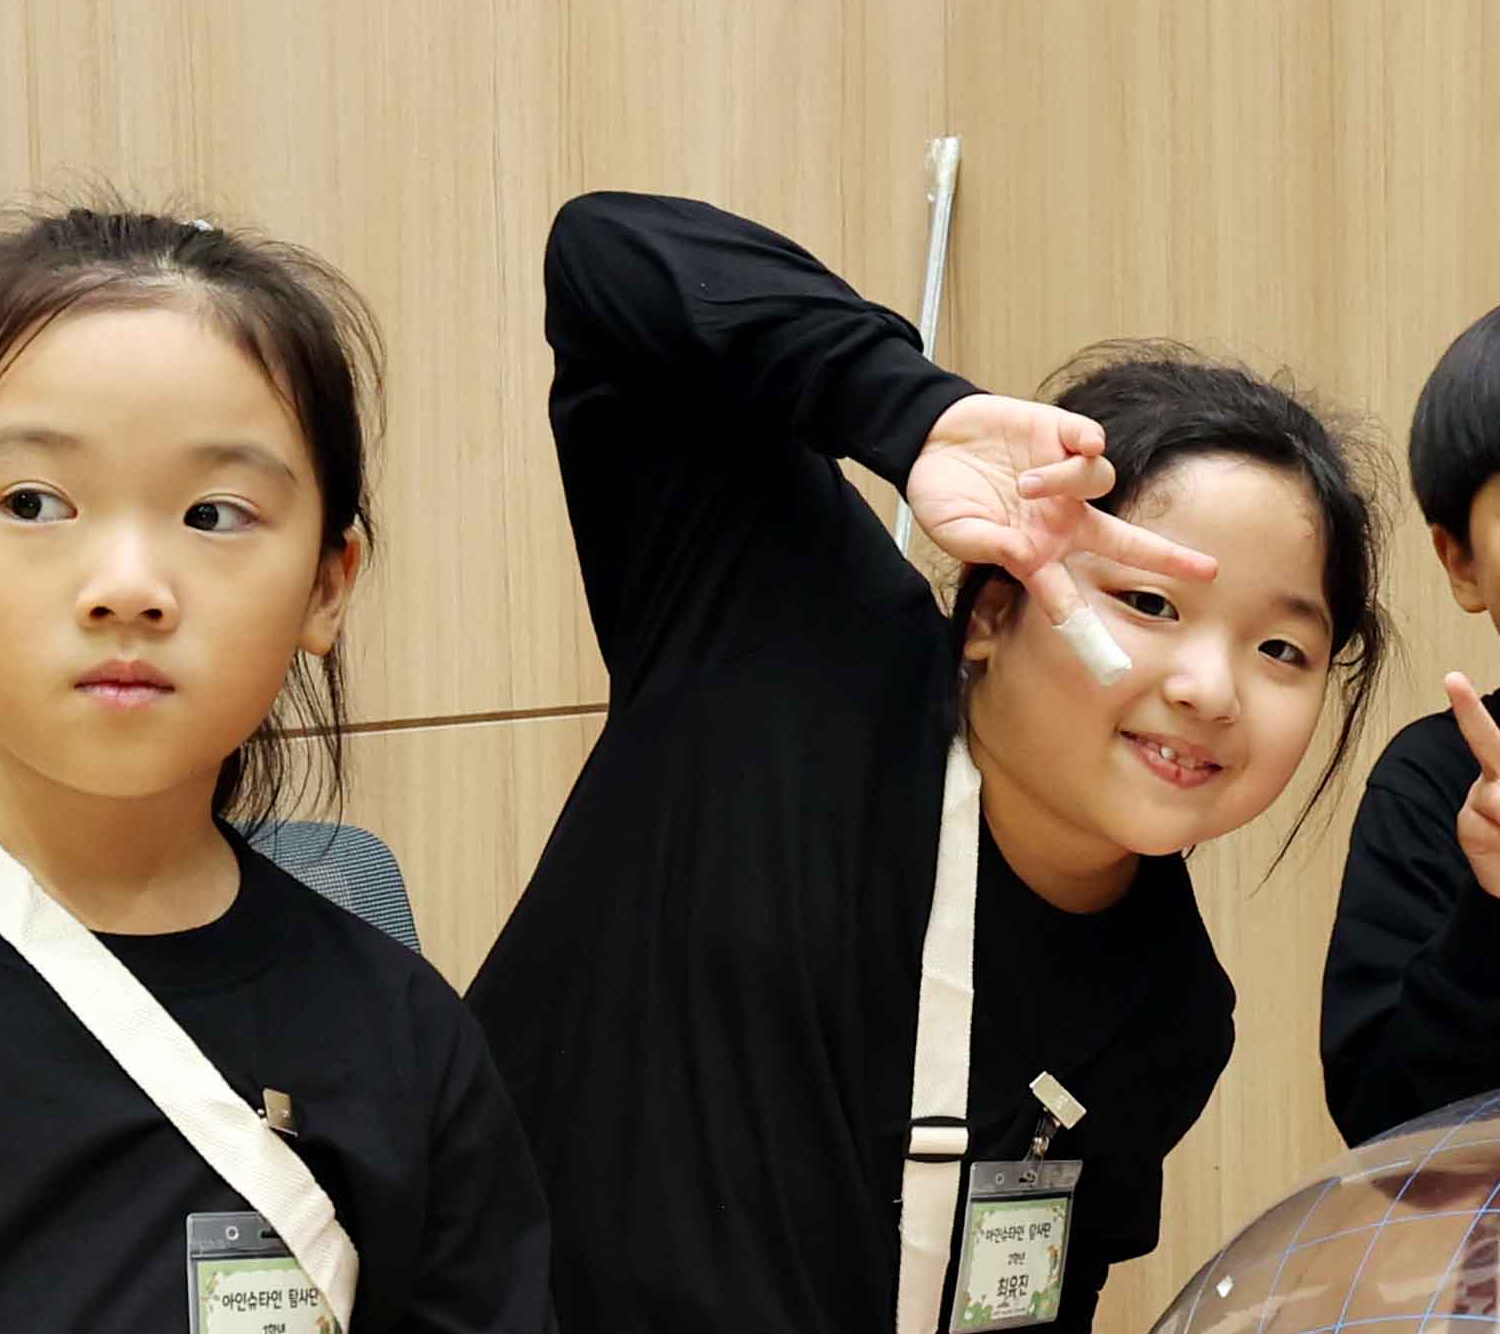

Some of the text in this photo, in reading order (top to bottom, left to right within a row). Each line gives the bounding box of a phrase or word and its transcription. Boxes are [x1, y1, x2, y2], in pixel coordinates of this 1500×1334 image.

[996, 1274, 1030, 1299] 최유진
[221, 1287, 319, 1312] 아인슈타인 탐사단
